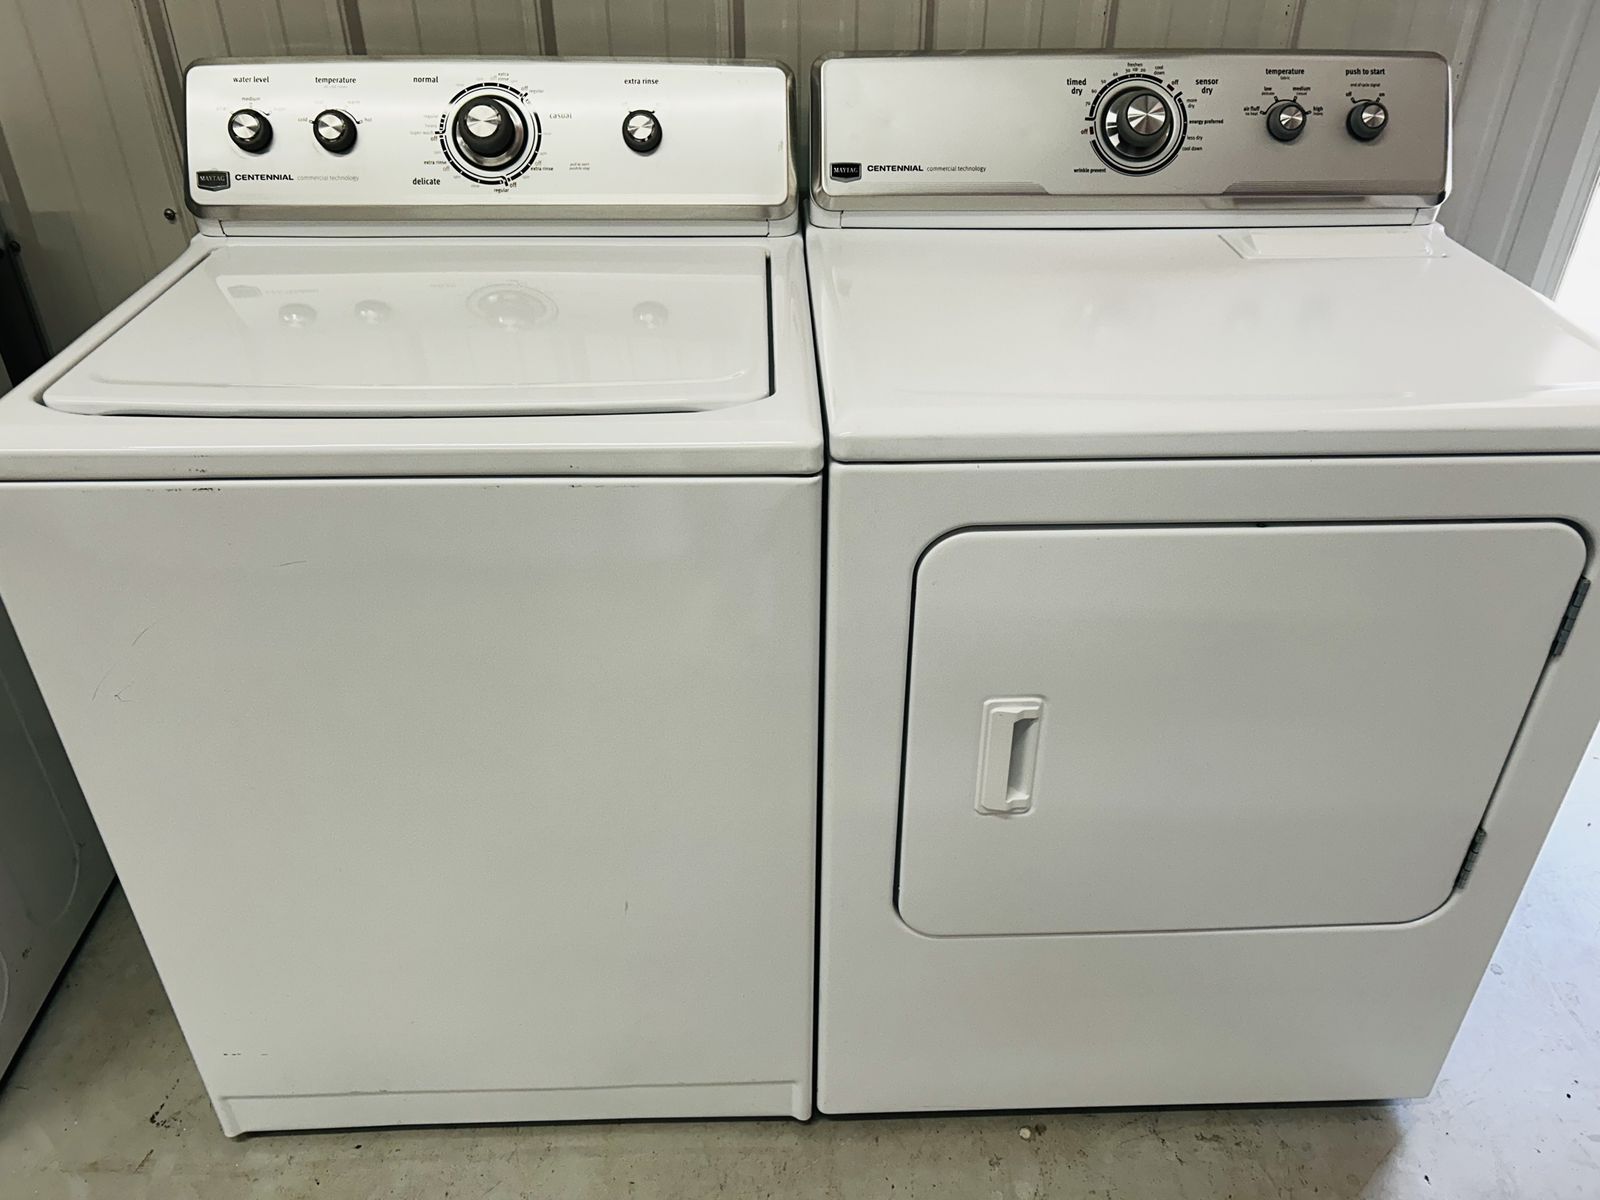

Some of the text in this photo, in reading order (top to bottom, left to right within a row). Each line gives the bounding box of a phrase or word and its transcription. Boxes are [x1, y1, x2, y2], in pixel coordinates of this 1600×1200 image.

[1265, 68, 1304, 76] temperature
[1345, 68, 1361, 76] push
[1066, 78, 1086, 86] timed
[1071, 86, 1083, 96] dry
[1201, 86, 1213, 96] dry
[957, 165, 986, 173] technology
[297, 174, 329, 182] commercial
[329, 174, 359, 182] technology
[412, 177, 441, 185] delicate
